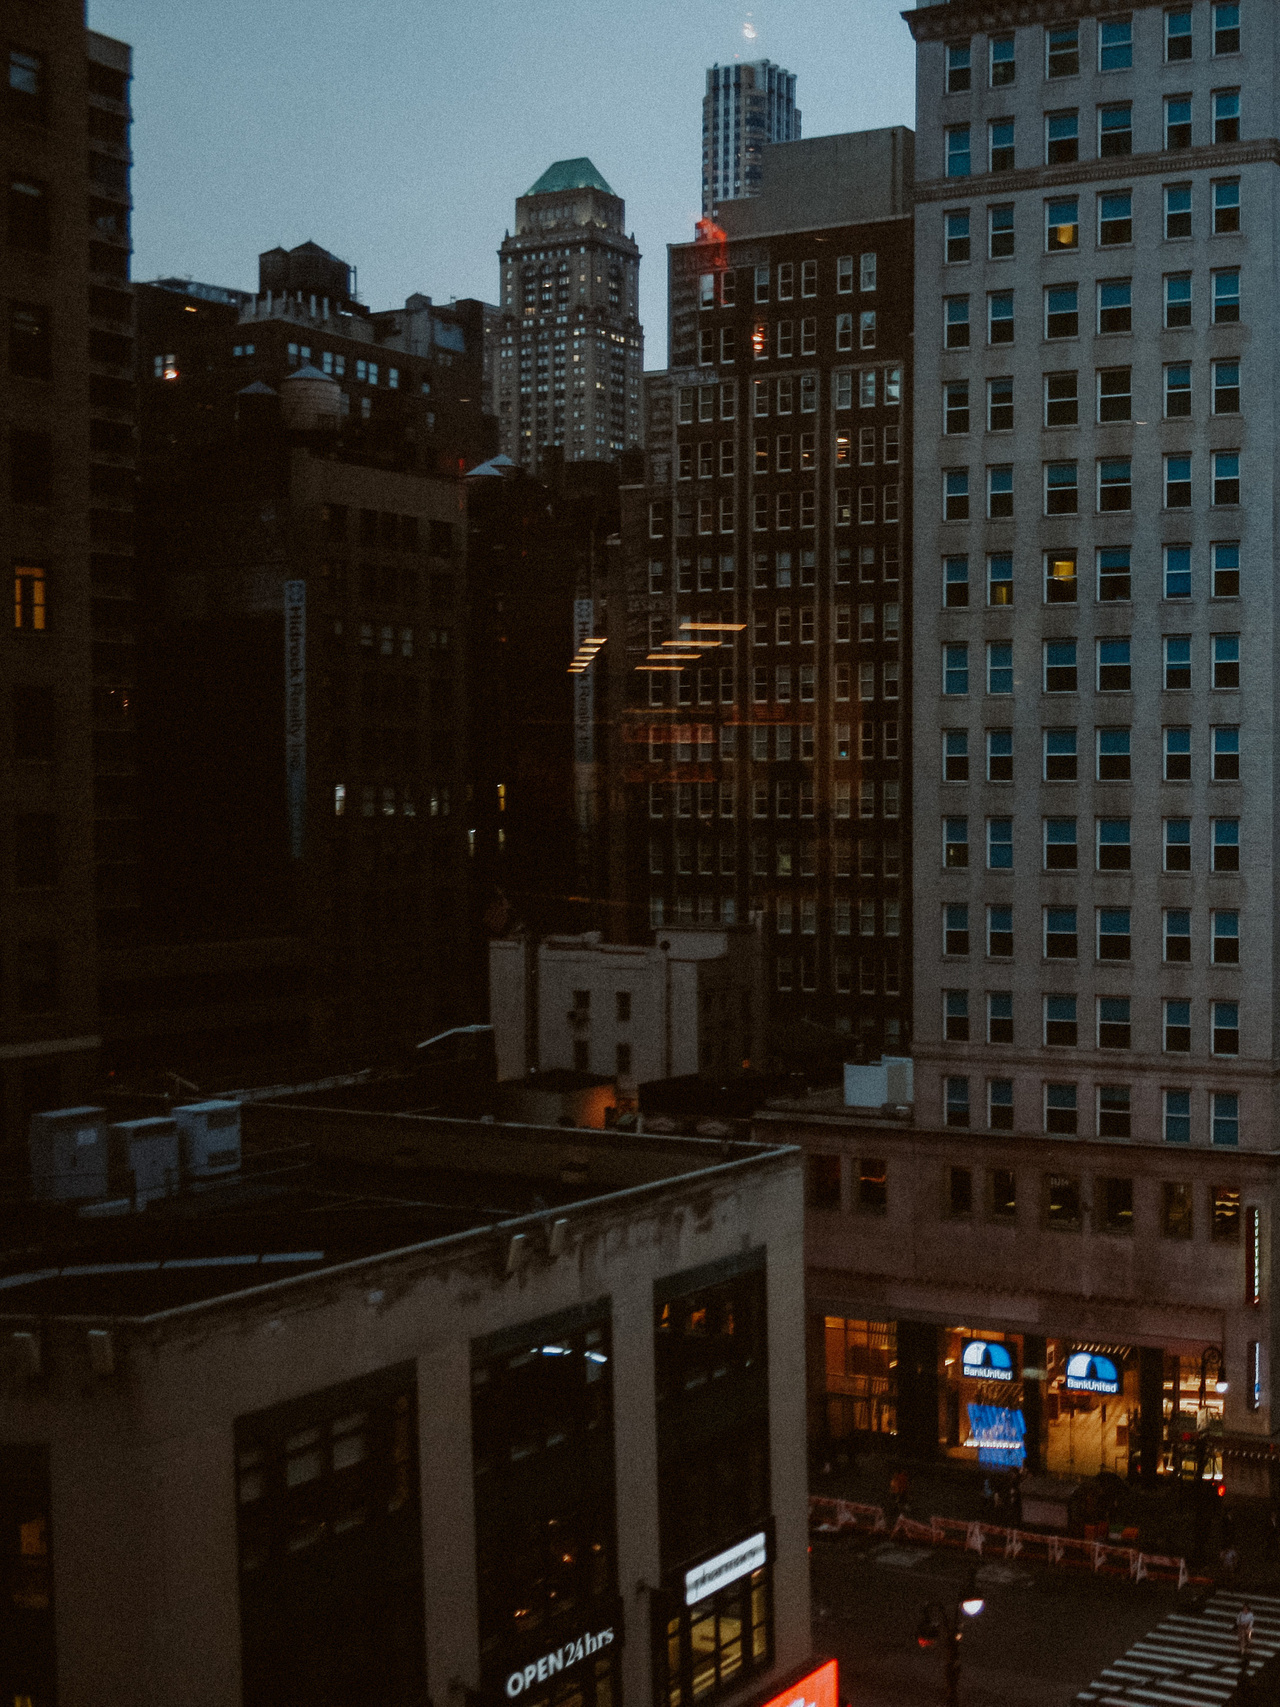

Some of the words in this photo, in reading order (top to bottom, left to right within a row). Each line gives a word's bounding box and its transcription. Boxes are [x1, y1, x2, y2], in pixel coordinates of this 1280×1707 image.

[289, 606, 302, 678] Hidrock
[288, 683, 302, 737] Realty
[963, 1366, 1013, 1381] BankUnited
[1067, 1378, 1118, 1394] BankUnited
[505, 1647, 564, 1699] OPEN
